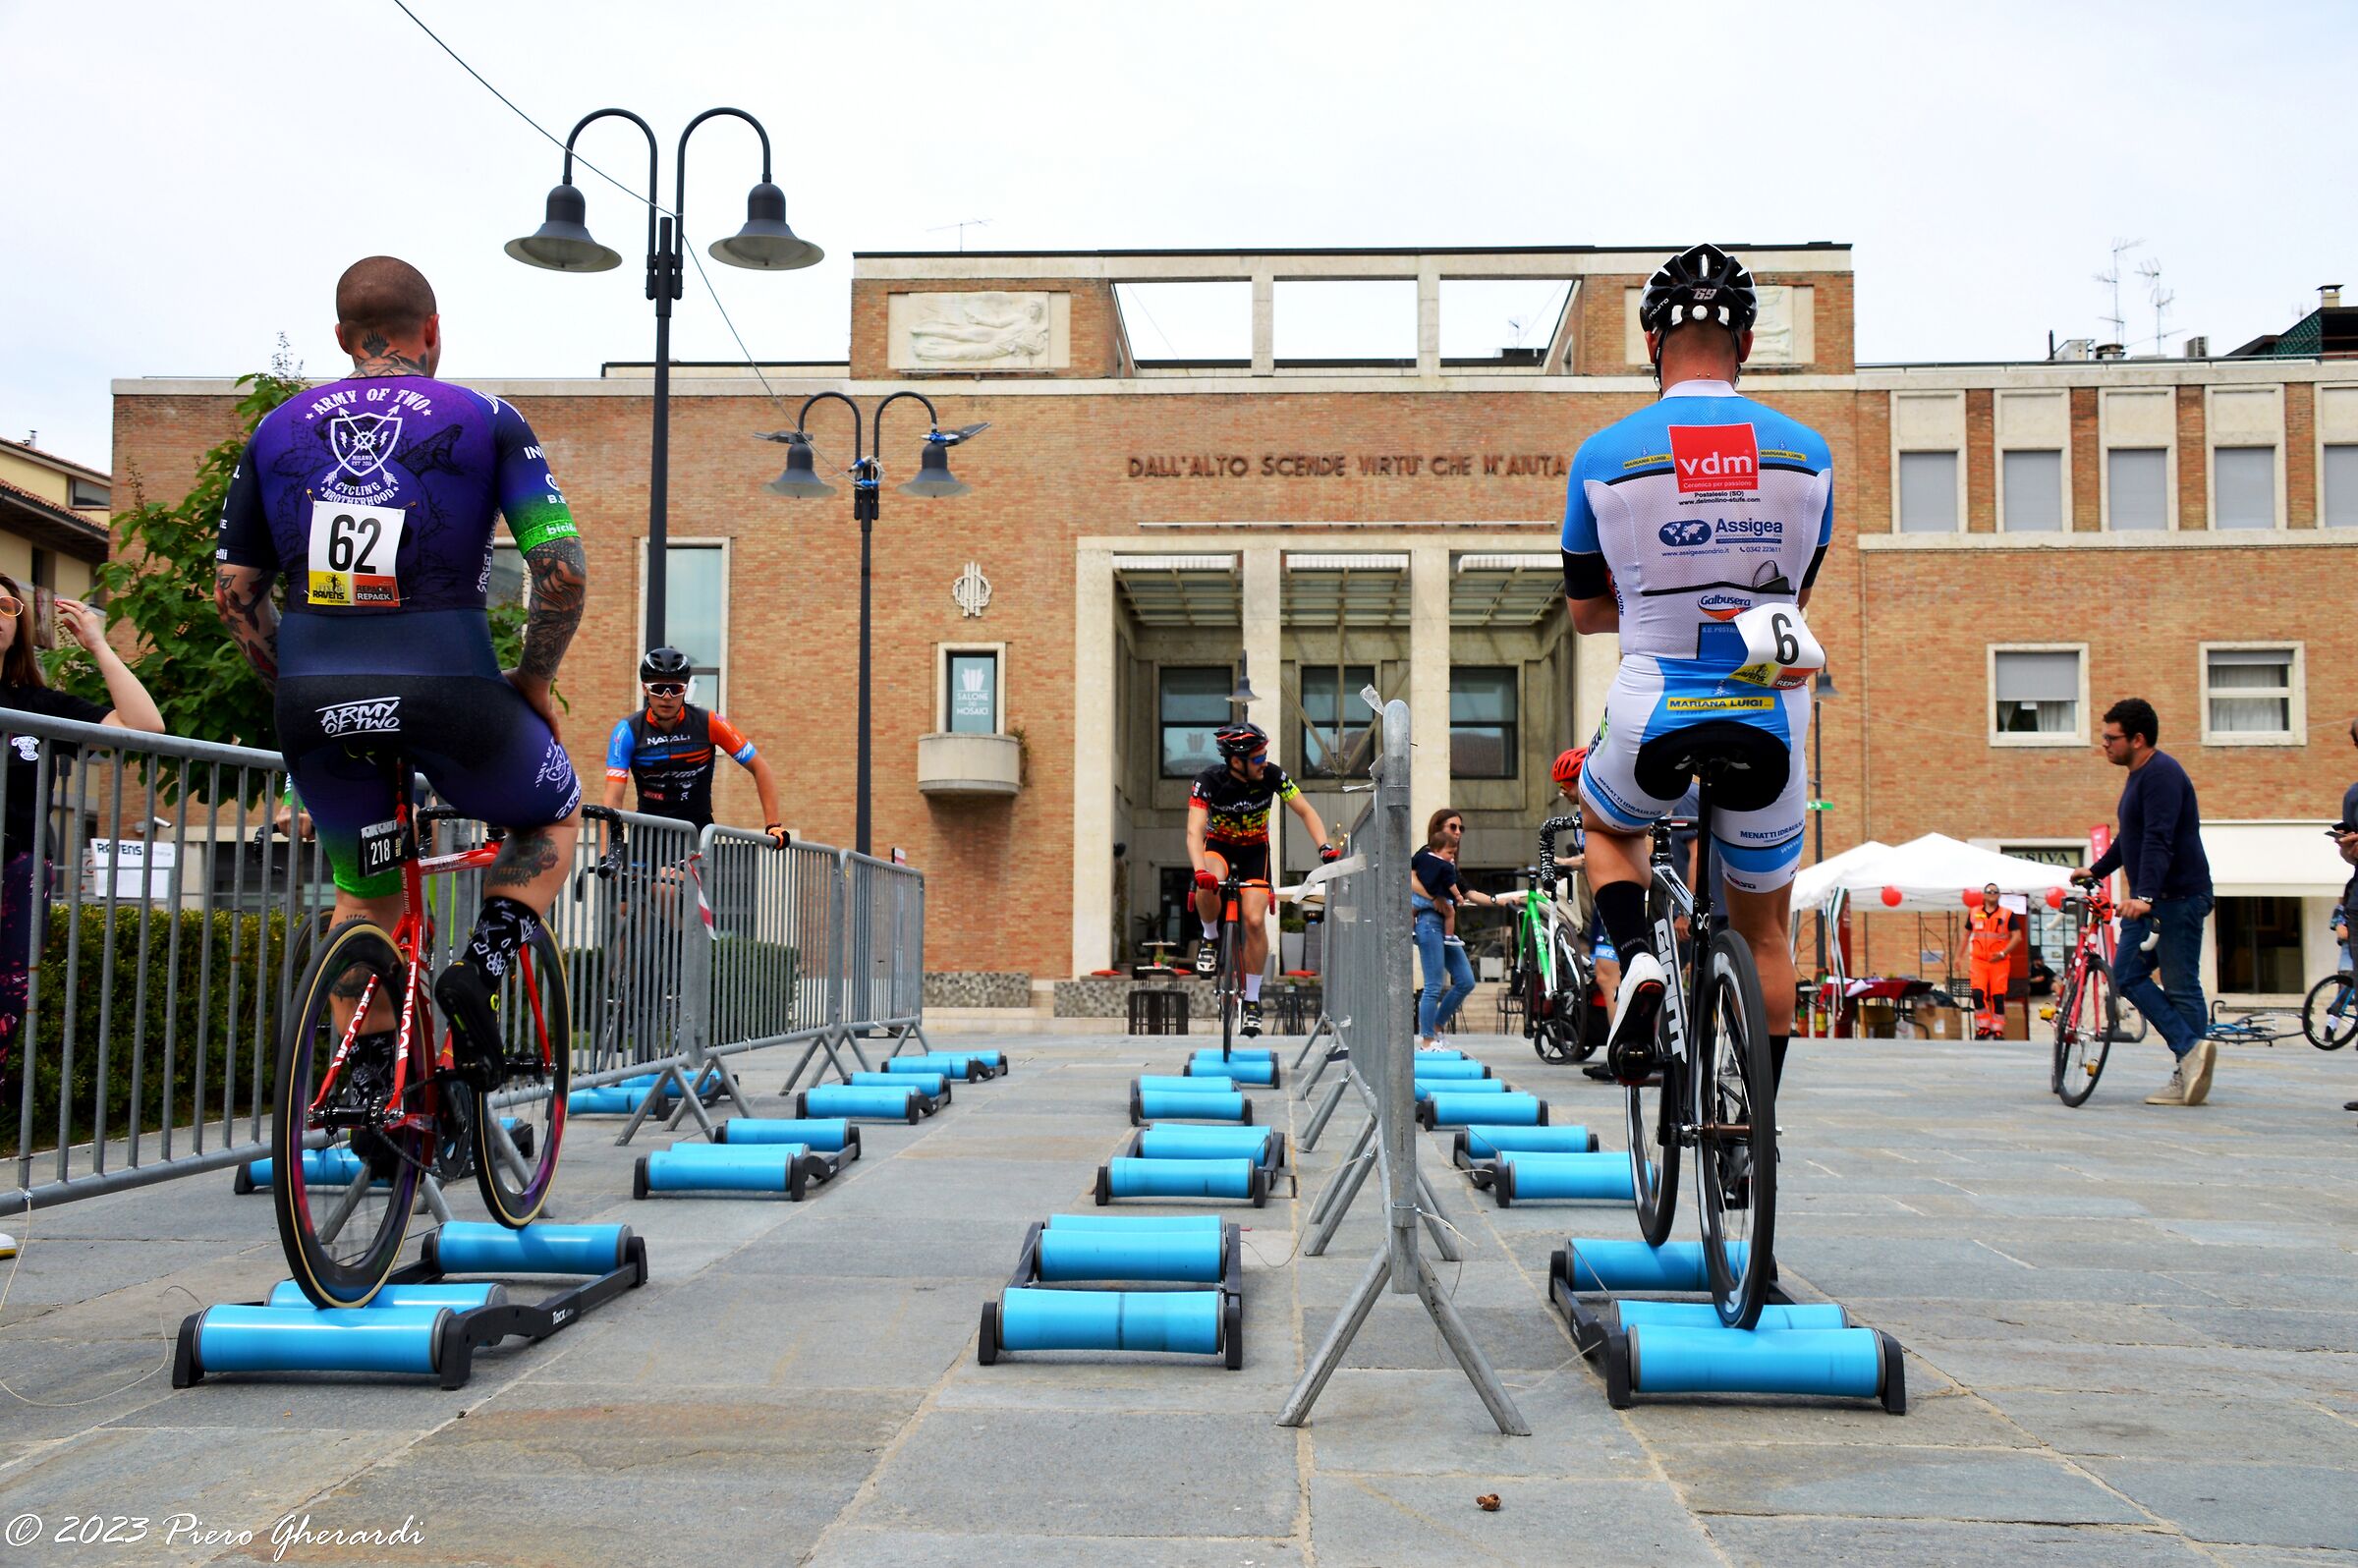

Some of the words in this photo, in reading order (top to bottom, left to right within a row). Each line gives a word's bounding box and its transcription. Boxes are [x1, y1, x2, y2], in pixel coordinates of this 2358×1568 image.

[311, 390, 357, 416] ARMY
[365, 388, 390, 402] OF
[394, 389, 431, 411] TWO
[1128, 455, 1249, 477] DALL'ALTO
[1261, 455, 1346, 477] SCENDE
[1431, 455, 1472, 477] CHE
[1483, 455, 1566, 477] M'AIUTA
[1679, 451, 1753, 476] vdm
[322, 488, 395, 507] BROTHERHOOD
[334, 481, 381, 497] CYCLING
[1715, 517, 1783, 536] Assigea
[328, 514, 382, 575] 62
[477, 554, 492, 594] STREET
[357, 592, 391, 601] REPACK
[1700, 594, 1752, 607] Galbusera
[1771, 612, 1800, 665] 6
[957, 692, 989, 700] SALONE
[1729, 699, 1764, 707] LUIGI
[320, 700, 400, 727] ARMY
[324, 719, 352, 734] OF
[354, 716, 400, 730] TWO
[1740, 830, 1776, 839] MENATTI
[370, 838, 391, 866] 218
